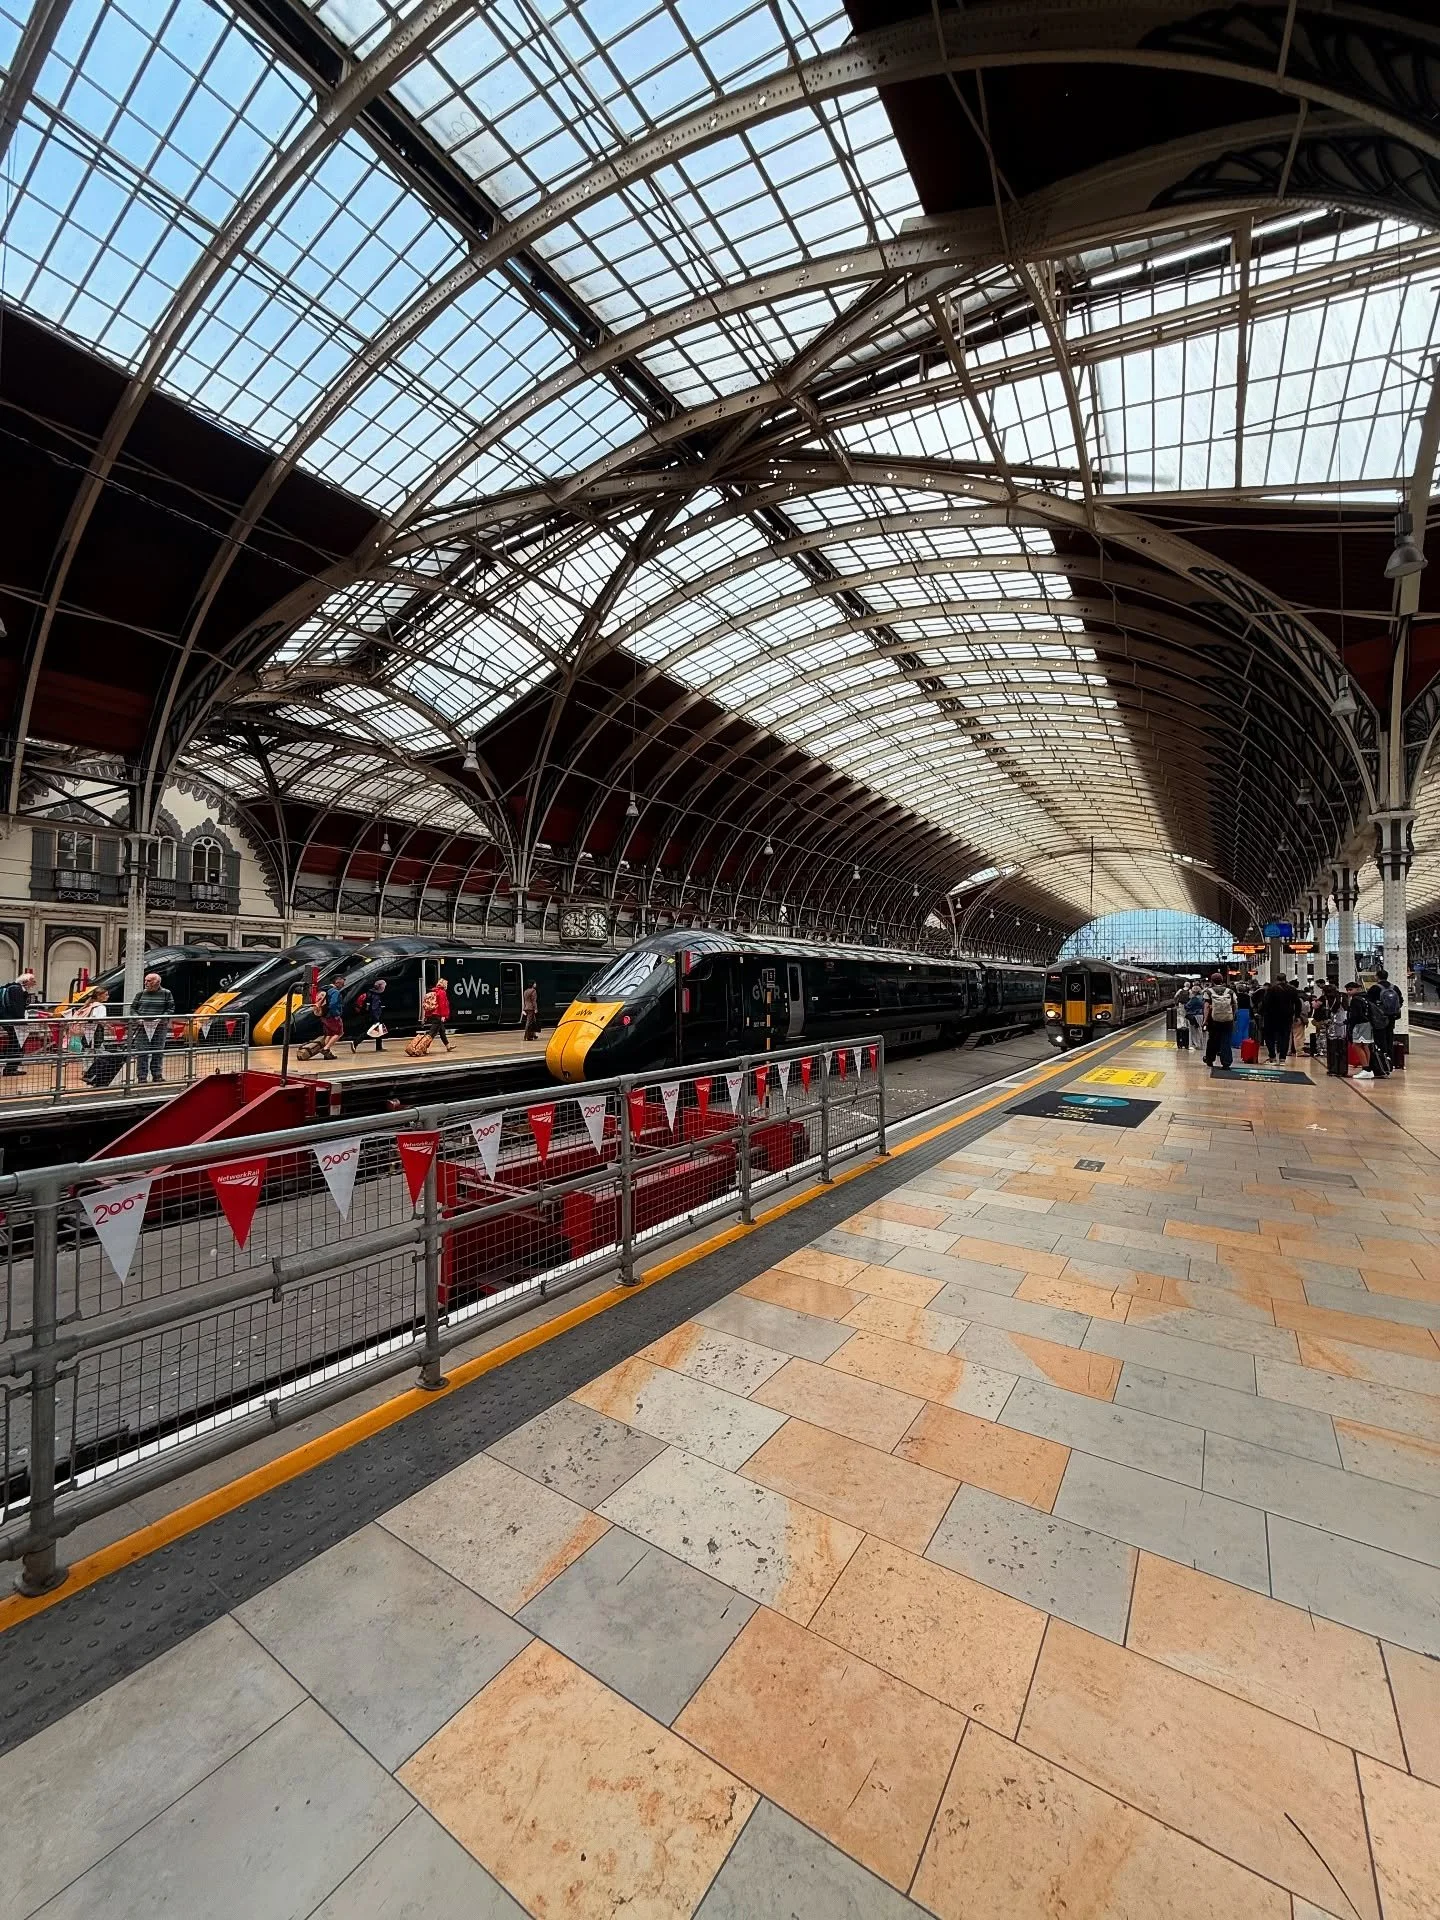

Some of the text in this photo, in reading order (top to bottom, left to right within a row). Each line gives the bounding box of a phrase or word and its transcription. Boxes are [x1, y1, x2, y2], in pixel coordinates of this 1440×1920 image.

[453, 975, 490, 999] GWR
[584, 1105, 601, 1118] 200
[475, 1126, 496, 1142] 200
[322, 1151, 351, 1172] 200
[93, 1198, 135, 1226] 200
